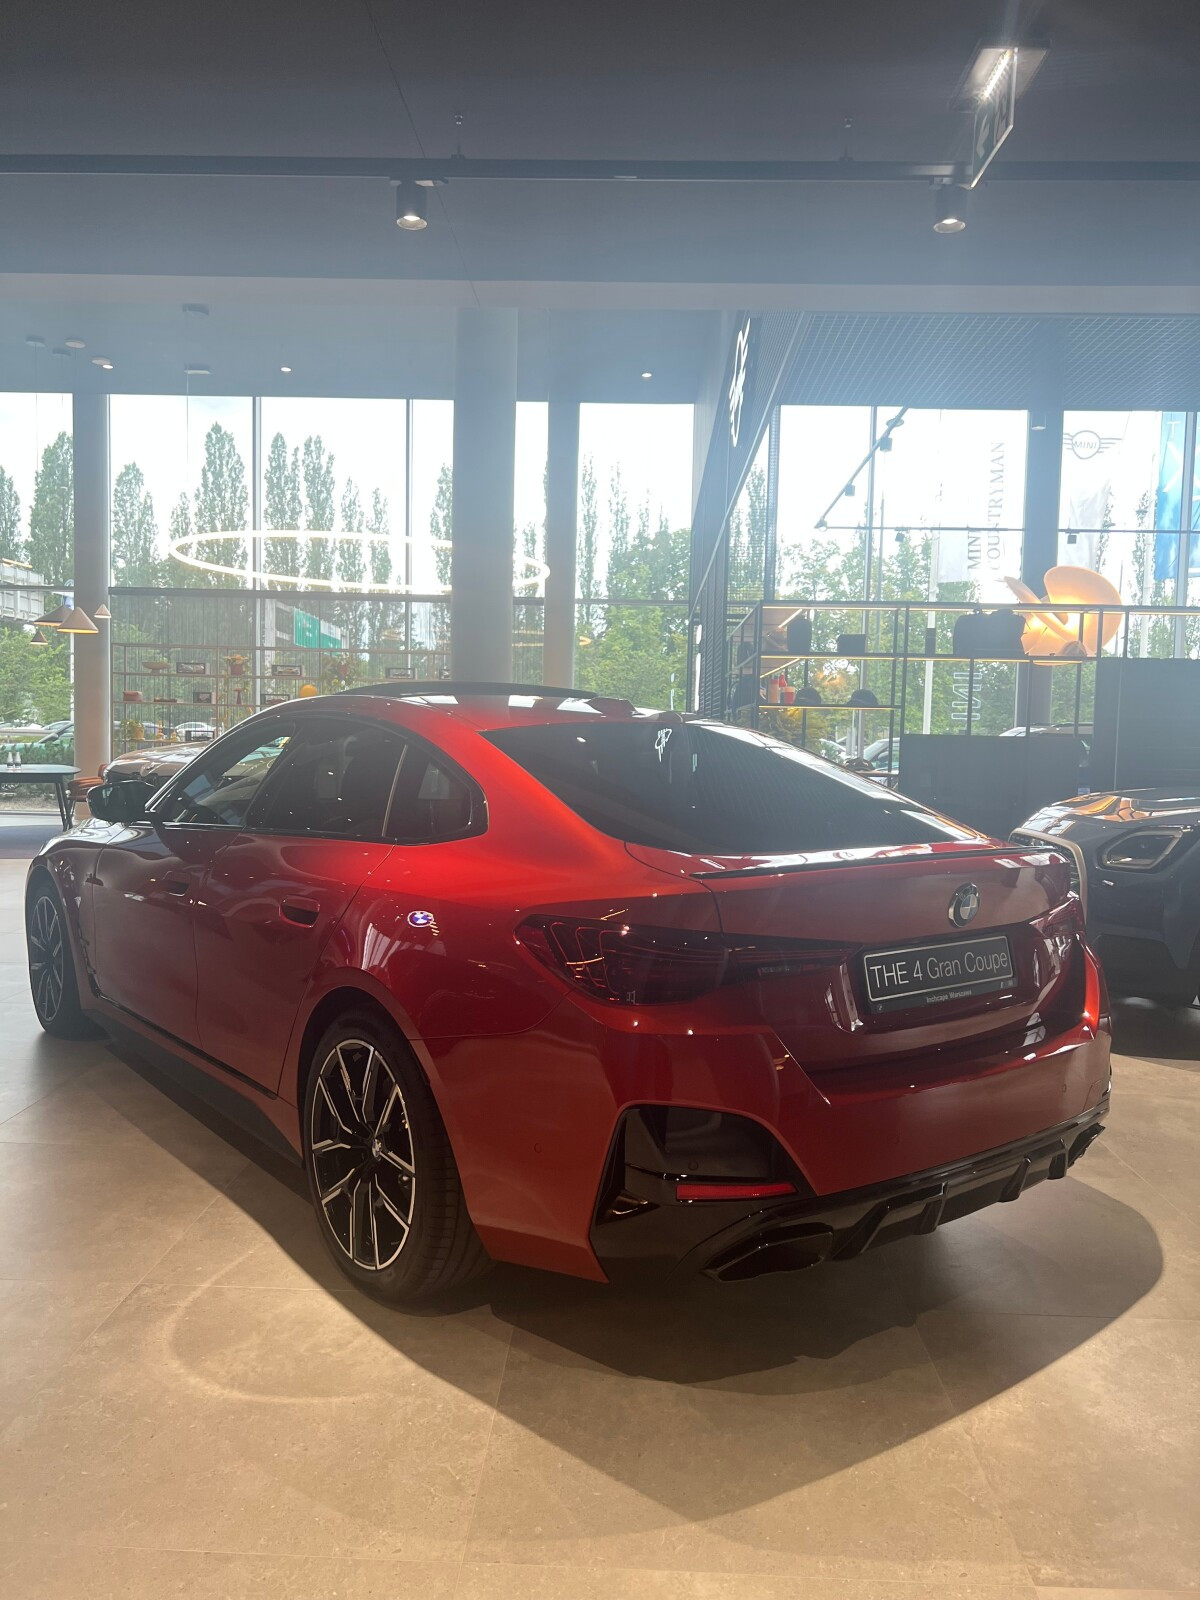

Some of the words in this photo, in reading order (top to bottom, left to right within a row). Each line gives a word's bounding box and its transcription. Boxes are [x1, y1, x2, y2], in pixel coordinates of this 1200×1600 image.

[869, 961, 909, 988] THE
[913, 960, 923, 981] 4
[926, 957, 961, 979] Gran
[964, 951, 1008, 973] Coupe
